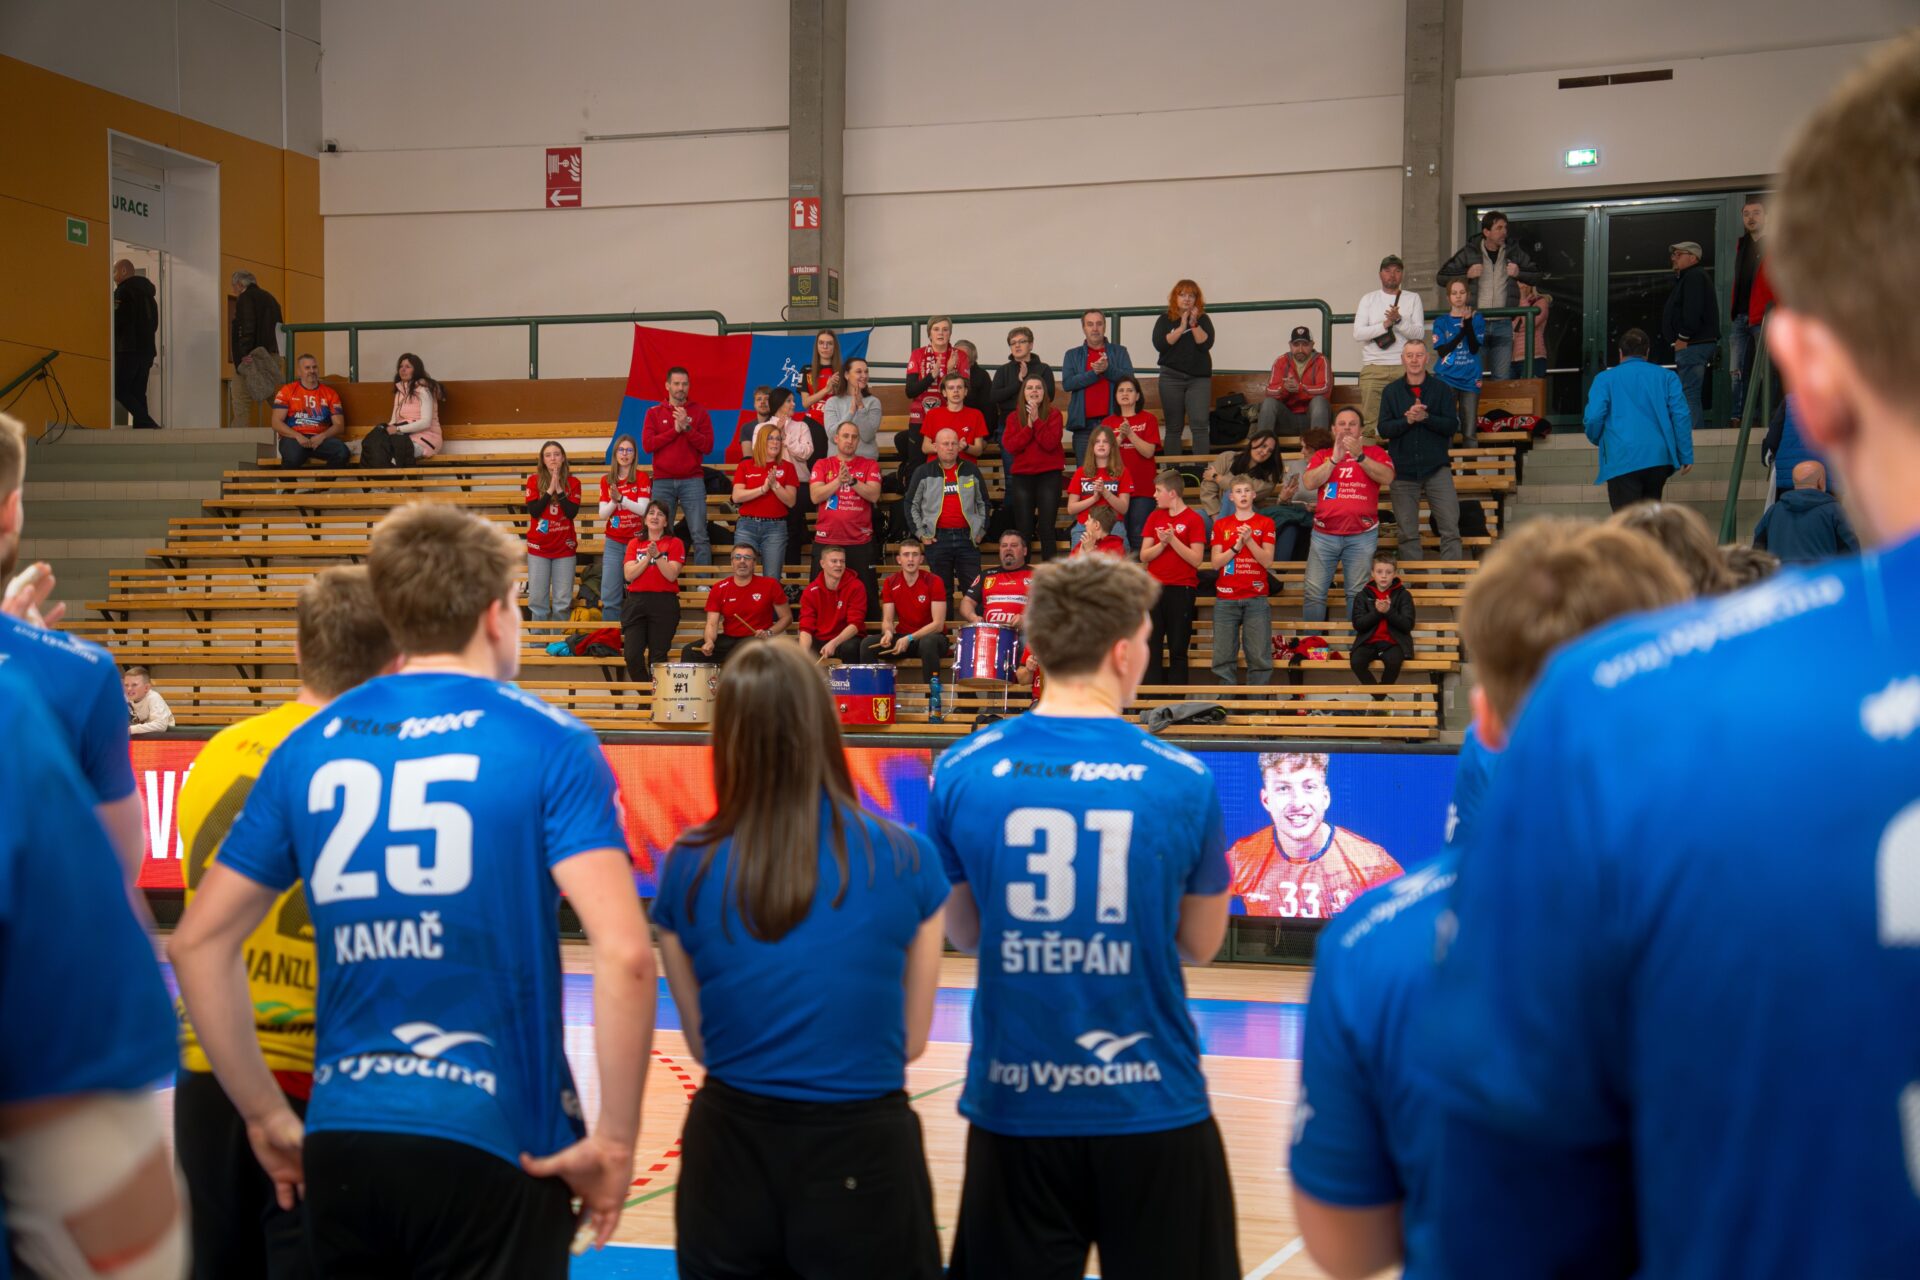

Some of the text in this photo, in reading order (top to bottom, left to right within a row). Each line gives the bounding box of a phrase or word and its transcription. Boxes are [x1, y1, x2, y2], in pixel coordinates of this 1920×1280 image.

[303, 394, 316, 408] 16
[1339, 467, 1353, 478] 72
[989, 612, 1015, 623] ZDT
[672, 672, 689, 680] Koky
[673, 682, 689, 693] #1
[308, 753, 480, 906] 25
[1004, 807, 1134, 924] 31
[1278, 881, 1321, 918] 33
[334, 911, 443, 965] KAKAČ
[1001, 930, 1132, 975] ŠTĚPÁN
